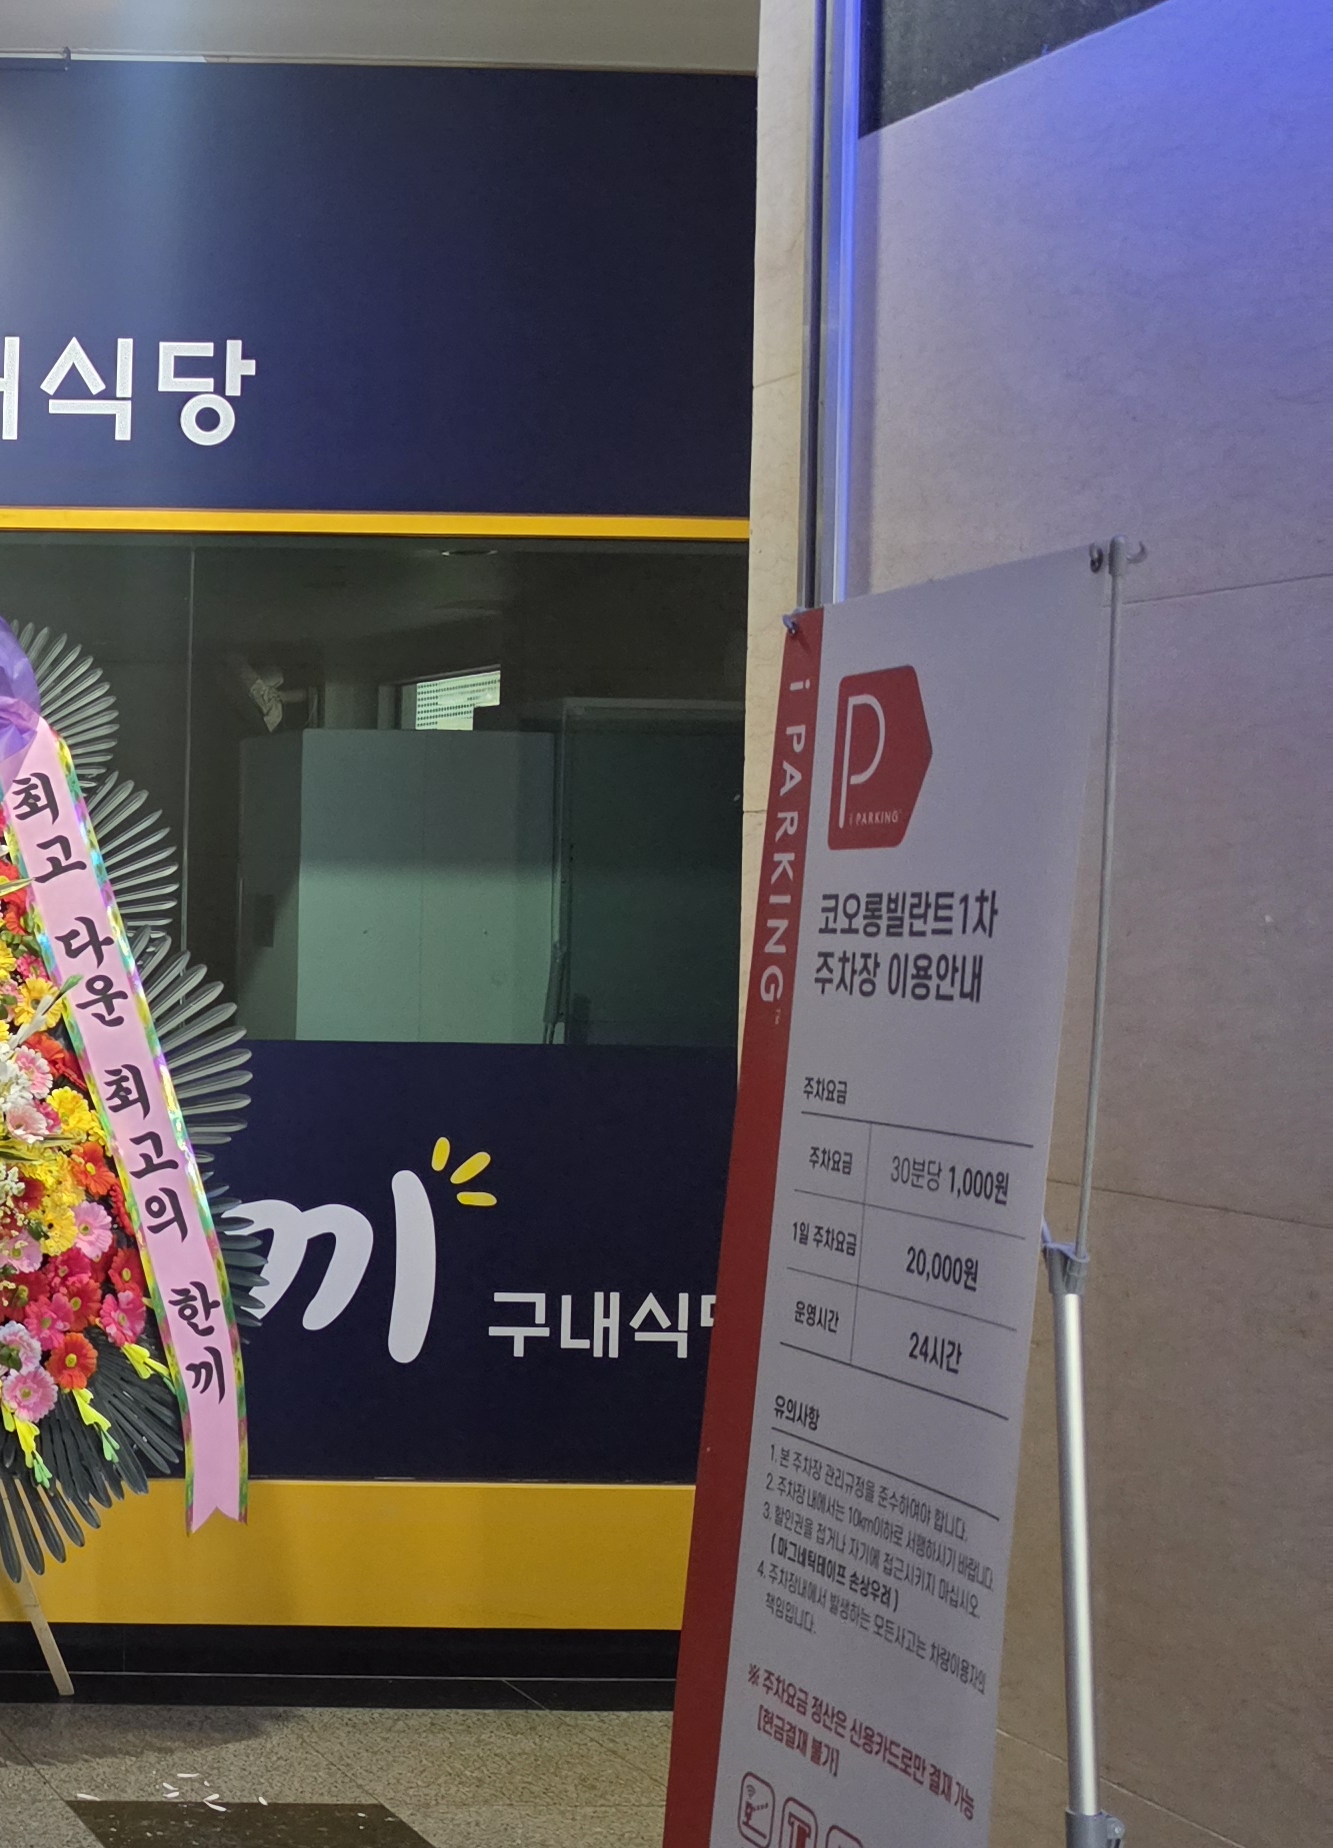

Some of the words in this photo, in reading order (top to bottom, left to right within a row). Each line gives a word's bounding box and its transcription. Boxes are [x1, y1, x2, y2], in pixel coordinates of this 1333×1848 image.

[855, 809, 899, 826] PARKING
[760, 724, 806, 1003] PARKING
[814, 950, 881, 999] 주차장
[887, 951, 984, 1003] 이용안내
[12, 772, 89, 886] 최고
[55, 914, 130, 1030] 다운
[106, 1063, 191, 1245] 최고의
[167, 1278, 230, 1406] 한끼
[803, 1077, 848, 1105] 주차요금
[808, 1146, 853, 1175] 주차요금
[890, 1155, 943, 1192] 30분당
[948, 1165, 1010, 1206] 1,000원
[792, 1221, 810, 1246] 1일
[812, 1226, 858, 1256] 주차요금
[906, 1245, 979, 1292] 20,000원
[794, 1301, 840, 1333] 운영시간
[908, 1331, 962, 1374] 24시간
[773, 1394, 821, 1431] 유의사항
[771, 1444, 778, 1463] 1.
[779, 1447, 790, 1469] 본
[792, 1451, 823, 1481] 주차장
[824, 1463, 875, 1503] 관리규정을
[877, 1485, 932, 1527] 준수하여야
[934, 1508, 968, 1542] 합니다.
[757, 1560, 766, 1579] 4.
[829, 1592, 871, 1631] 발생하는
[762, 1501, 772, 1520] 3.
[774, 1504, 814, 1540] 할인권을
[816, 1522, 847, 1553] 접거나
[848, 1537, 881, 1569] 자기에
[883, 1552, 936, 1596] 접근시키지
[938, 1577, 981, 1619] 마십시오.
[905, 1529, 957, 1572] 서행하시기
[957, 1552, 994, 1592] 바랍니다.
[765, 1592, 817, 1634] 책임입니다.
[762, 1668, 809, 1716] 주차요금
[811, 1696, 848, 1739] 정산은
[849, 1719, 927, 1786] 신용카드로만
[954, 1781, 975, 1820] 가능
